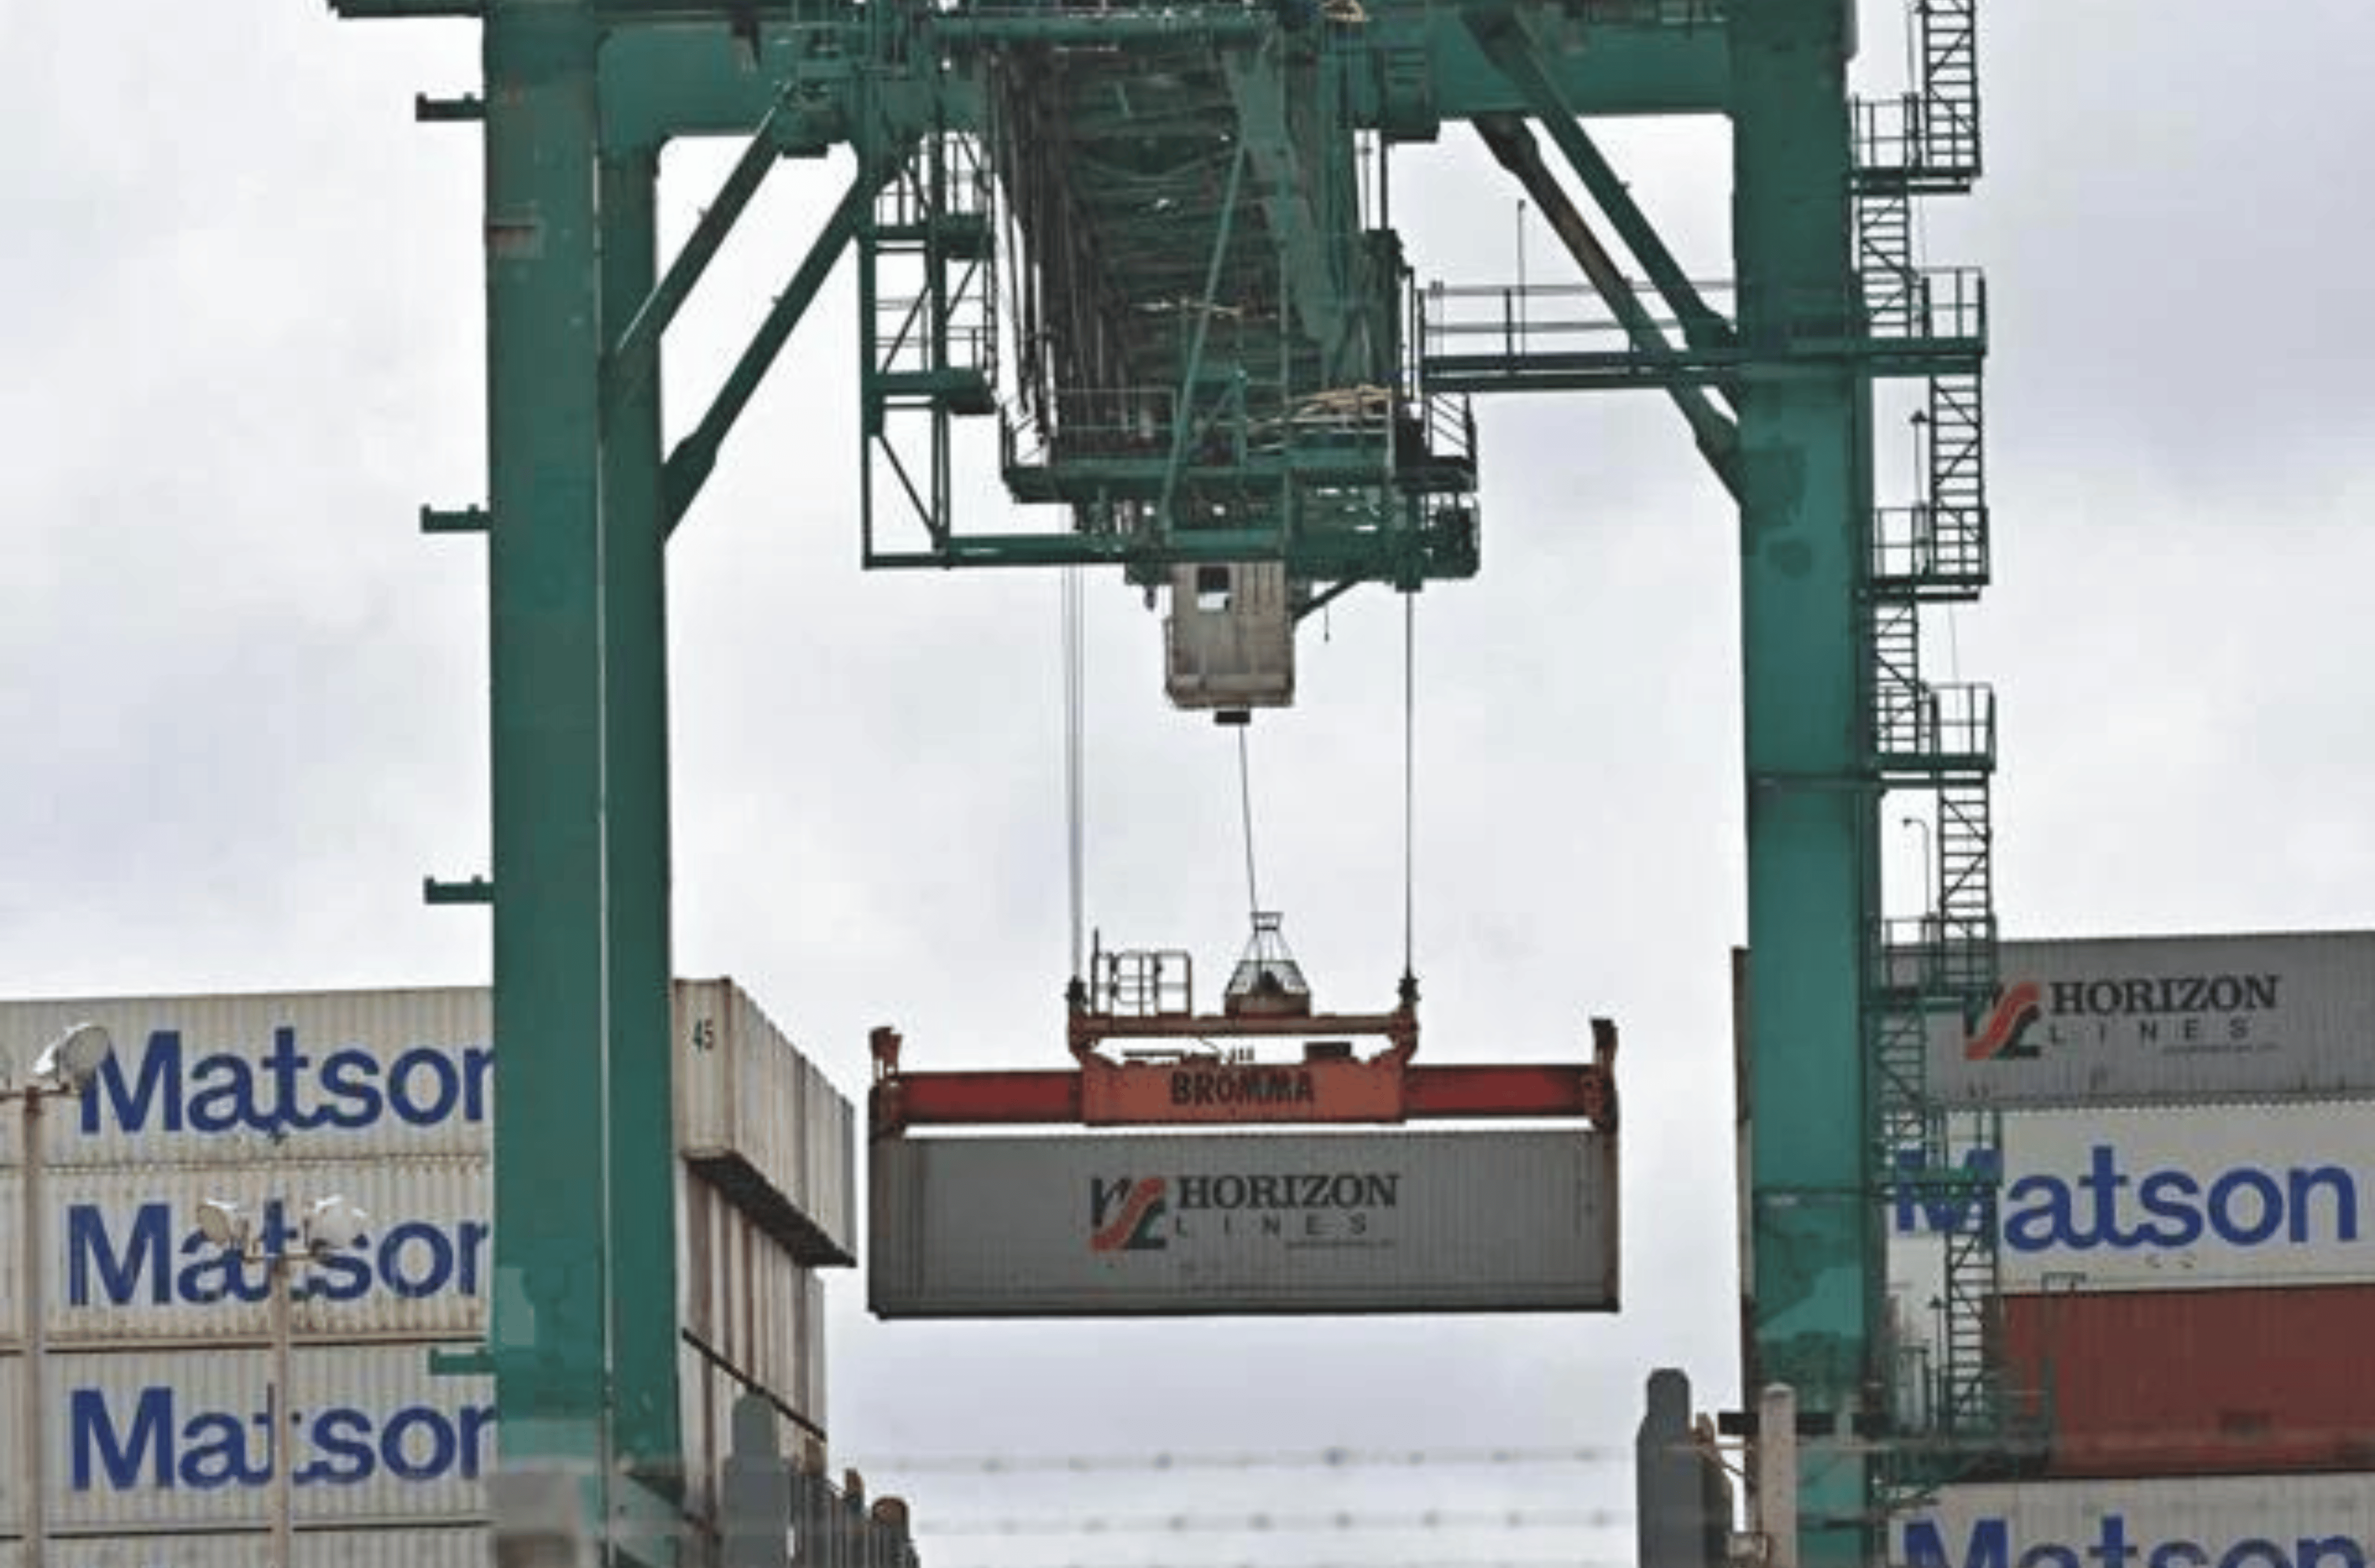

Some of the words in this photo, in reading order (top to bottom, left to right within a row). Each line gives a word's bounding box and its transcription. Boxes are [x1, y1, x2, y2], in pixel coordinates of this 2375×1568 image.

[2049, 975, 2280, 1014] HORIZON
[692, 1019, 715, 1052] 45
[2050, 1019, 2250, 1044] LINES
[1171, 1071, 1315, 1105] BROMMA
[1178, 1175, 1400, 1209] HORIZON
[1176, 1213, 1367, 1235] LINES
